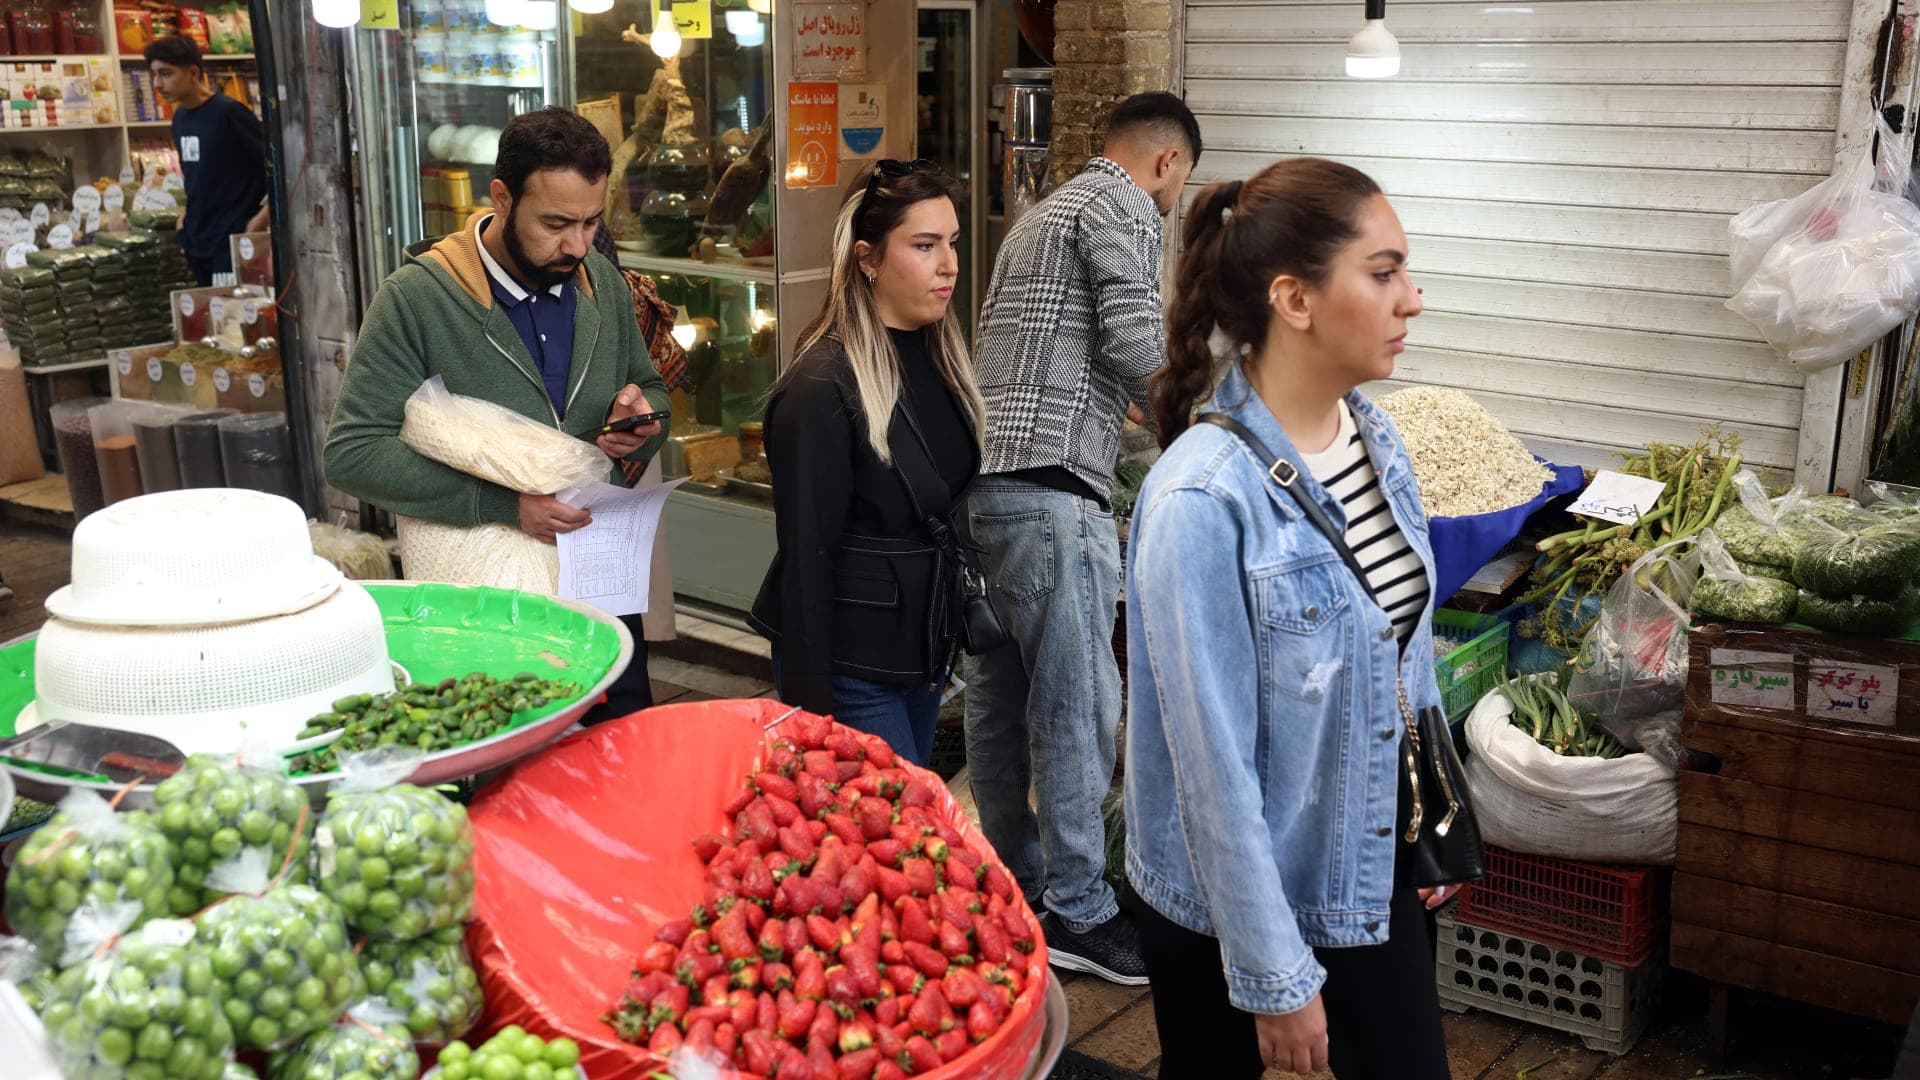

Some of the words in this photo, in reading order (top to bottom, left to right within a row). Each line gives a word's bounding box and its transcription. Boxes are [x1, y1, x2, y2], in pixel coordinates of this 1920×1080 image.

[798, 16, 818, 35] اصل
[819, 15, 846, 35] رویال
[847, 15, 861, 35] ژل
[803, 42, 824, 57] است
[825, 45, 856, 61] موجود
[790, 93, 812, 105] ماسک
[820, 93, 835, 105] لطفا
[816, 121, 832, 135] وارد
[1754, 675, 1789, 691] سیر
[1860, 674, 1881, 694] پلو
[1828, 699, 1853, 711] سیر
[1858, 695, 1869, 713] با
